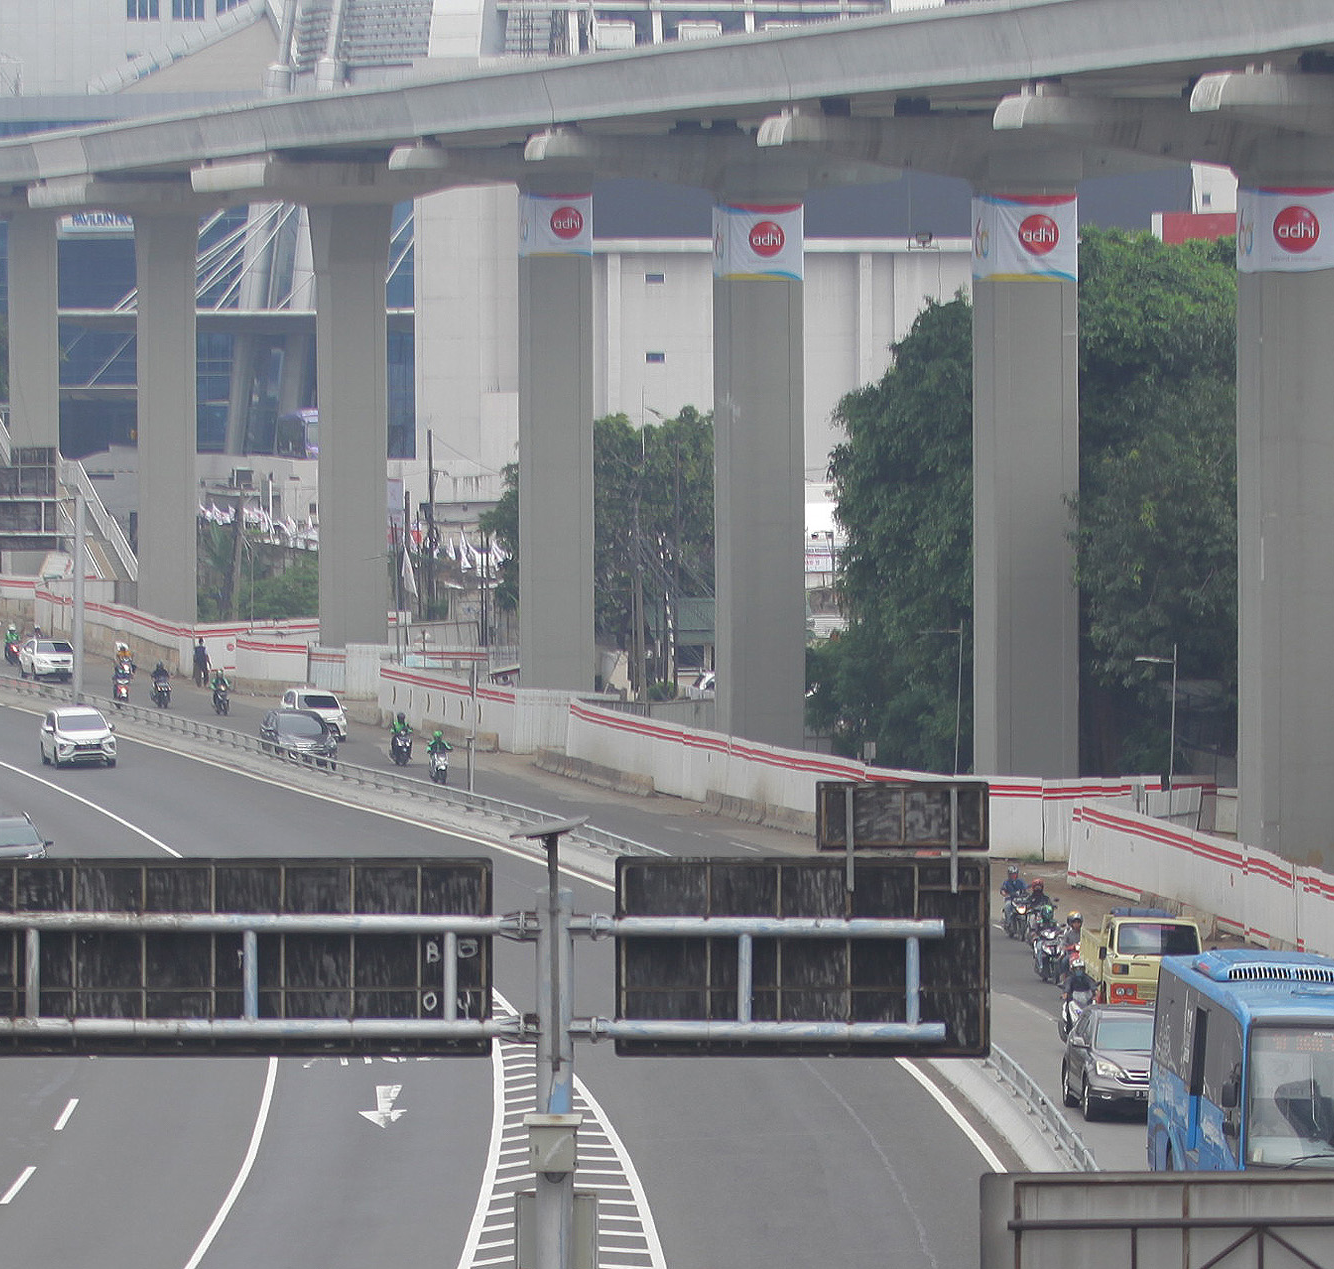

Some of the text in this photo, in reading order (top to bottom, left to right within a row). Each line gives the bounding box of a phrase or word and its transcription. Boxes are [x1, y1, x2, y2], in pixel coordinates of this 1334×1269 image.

[553, 216, 581, 230] adhi
[1277, 221, 1316, 239] adhi
[752, 231, 781, 247] adhi
[1022, 227, 1055, 243] adhi
